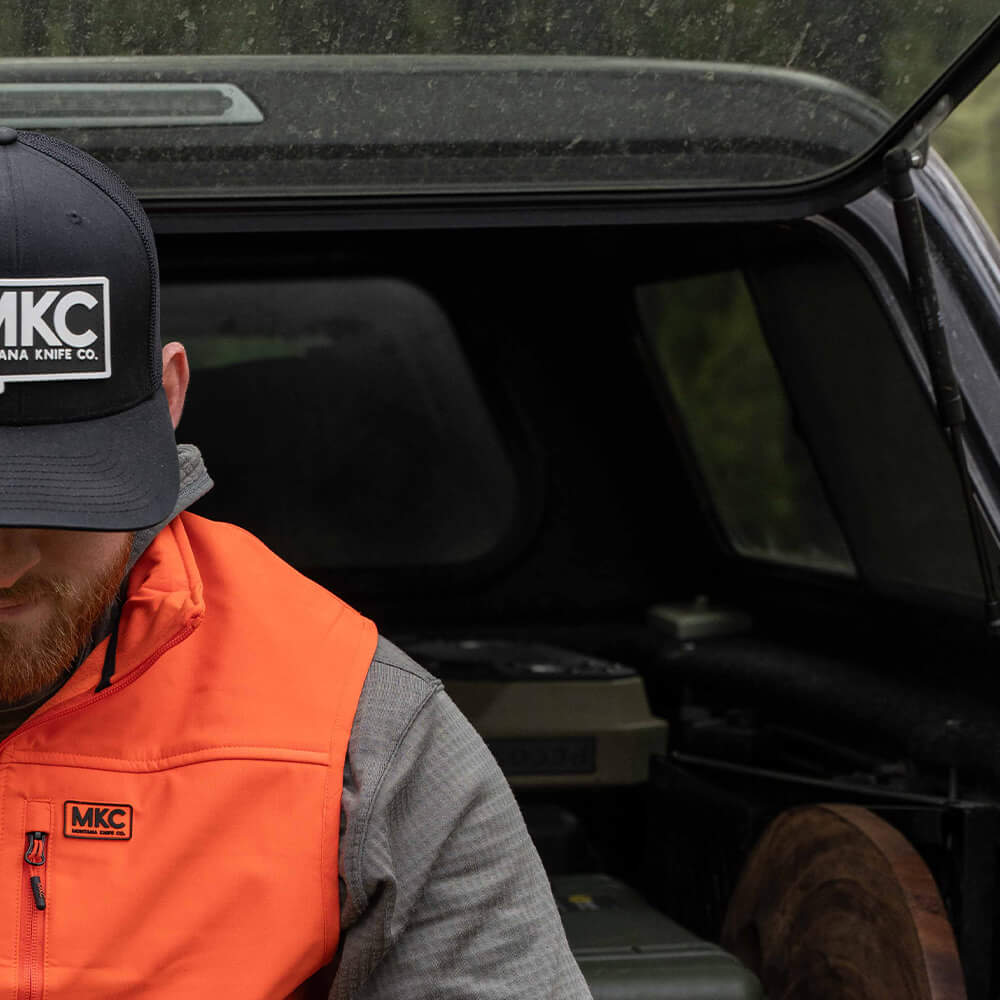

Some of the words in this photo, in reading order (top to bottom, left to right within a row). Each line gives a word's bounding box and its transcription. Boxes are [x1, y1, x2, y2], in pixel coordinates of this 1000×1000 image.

[35, 348, 73, 360] KNIFE
[76, 348, 99, 360] CO.
[71, 806, 126, 829] MKC
